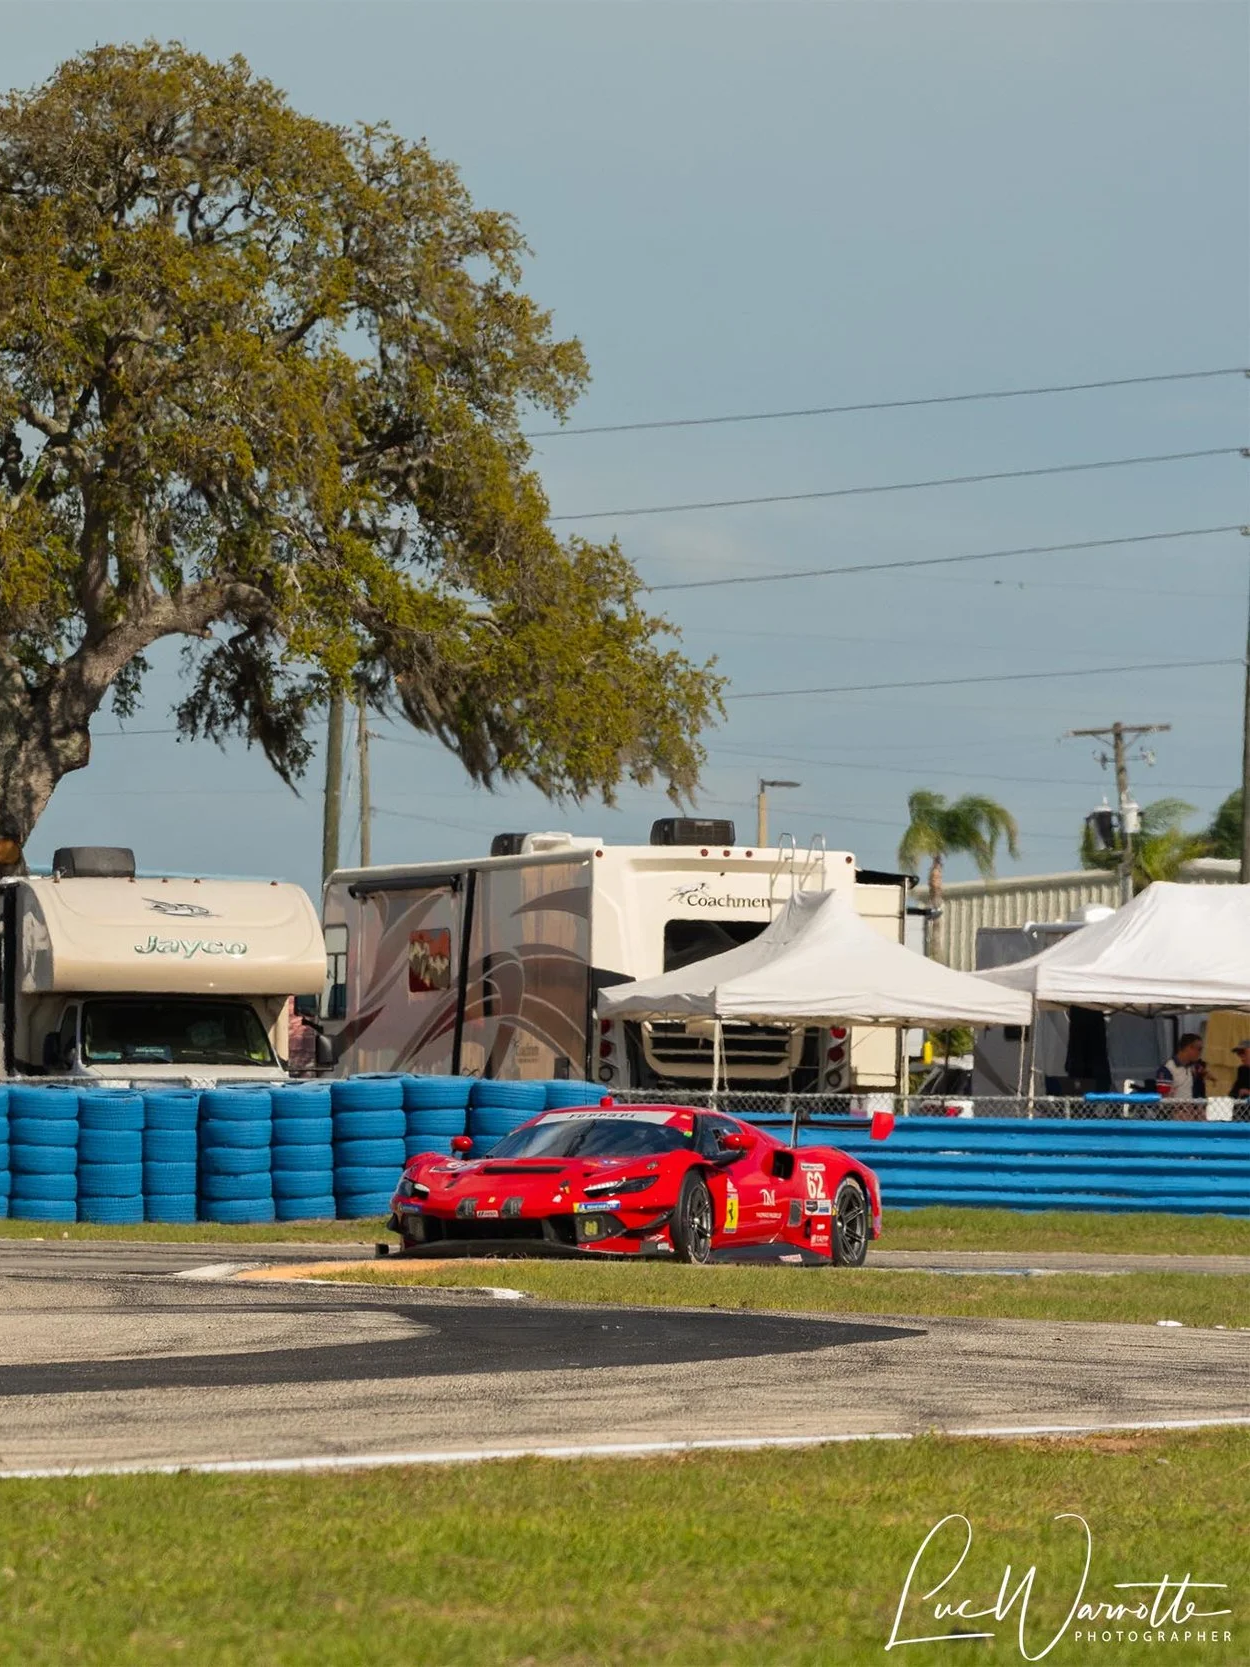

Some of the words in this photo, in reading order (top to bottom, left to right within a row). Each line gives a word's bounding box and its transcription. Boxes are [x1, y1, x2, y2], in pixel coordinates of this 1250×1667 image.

[687, 894, 771, 908] Coachmen
[134, 935, 248, 958] Jayco
[806, 1171, 826, 1199] 62
